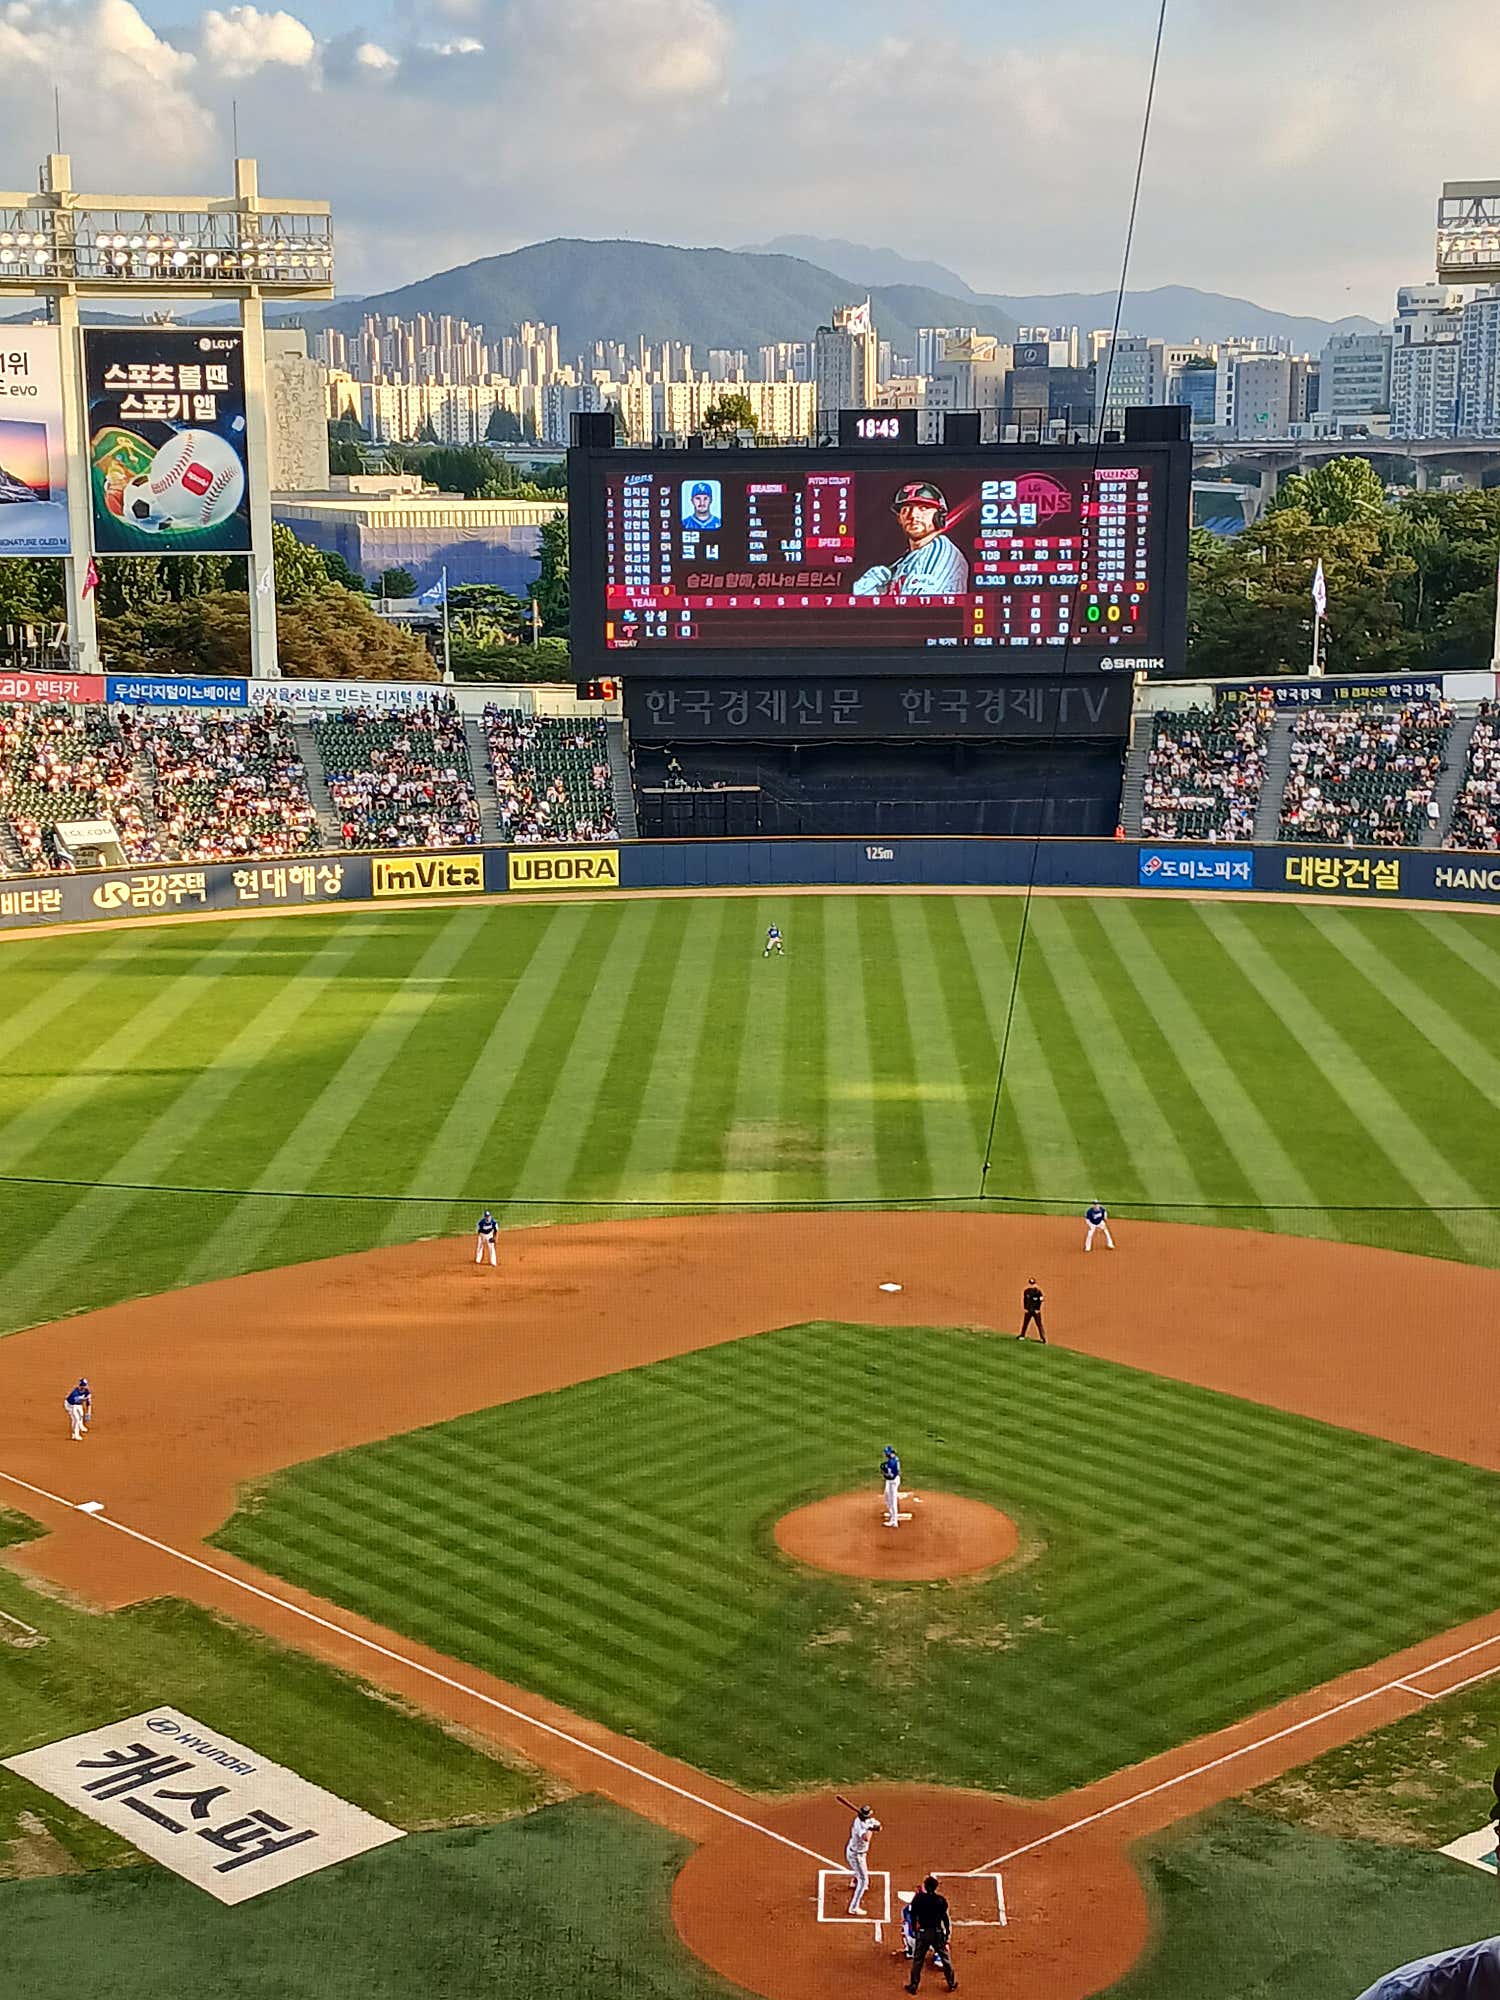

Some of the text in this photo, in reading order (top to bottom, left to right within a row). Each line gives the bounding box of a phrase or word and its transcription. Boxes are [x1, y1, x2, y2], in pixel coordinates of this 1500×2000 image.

[104, 364, 229, 390] 스포츠 볼 땐
[10, 385, 38, 396] evo
[120, 394, 217, 420] 스포키 앱
[857, 418, 900, 438] 18:43
[814, 488, 821, 498] T
[982, 481, 1017, 500] 23
[1084, 483, 1088, 491] 1
[794, 493, 802, 502] 7
[794, 505, 802, 514] 5
[839, 500, 847, 510] 2
[794, 516, 803, 526] 0
[839, 512, 847, 522] 7
[981, 503, 1037, 525] 오스틴
[794, 528, 803, 538] 0
[812, 525, 847, 535] K 0
[682, 532, 700, 543] 62
[608, 555, 614, 563] 7
[682, 544, 720, 560] 코너
[1010, 550, 1024, 560] 21
[1059, 549, 1072, 559] 11
[1081, 551, 1088, 559] 7
[1013, 574, 1044, 585] 0.371
[632, 598, 657, 608] TEAM
[683, 597, 689, 607] 1
[730, 597, 737, 607] 3
[754, 597, 761, 607] 4
[777, 597, 785, 607] 5
[801, 597, 809, 606] 6
[825, 597, 833, 606] 7
[848, 597, 857, 606] 8
[873, 597, 881, 606] 9
[895, 596, 908, 605] 10
[919, 596, 932, 605] 11
[943, 596, 956, 605] 12
[1090, 594, 1098, 604] B
[1110, 594, 1119, 604] S
[644, 610, 668, 622] 삼성
[681, 610, 691, 621] 0
[974, 608, 984, 619] 0
[1003, 608, 1010, 619] 1
[1030, 608, 1041, 618] 0
[1059, 608, 1069, 618] 0
[1087, 605, 1138, 621] 0 0 1
[681, 625, 691, 636] 0
[974, 624, 984, 634] 0
[1003, 623, 1010, 634] 1
[1030, 623, 1041, 634] 0
[1059, 622, 1069, 633] 0
[1113, 658, 1165, 669] SAMIK
[35, 680, 79, 698] 렌터카
[115, 683, 241, 701] 두산디지털이노베이션
[643, 688, 863, 725] 한국경제신문
[900, 687, 1109, 724] 한국경제TV
[866, 846, 894, 860] 125m
[511, 857, 617, 882] UBORA
[1160, 859, 1251, 881] 도미노피자
[1285, 856, 1400, 891] 대방건설
[232, 863, 344, 900] 현대해상
[131, 872, 206, 908] 금강주택
[174, 1732, 257, 1777] HYUNDAI
[75, 1743, 320, 1873] 캐스퍼
